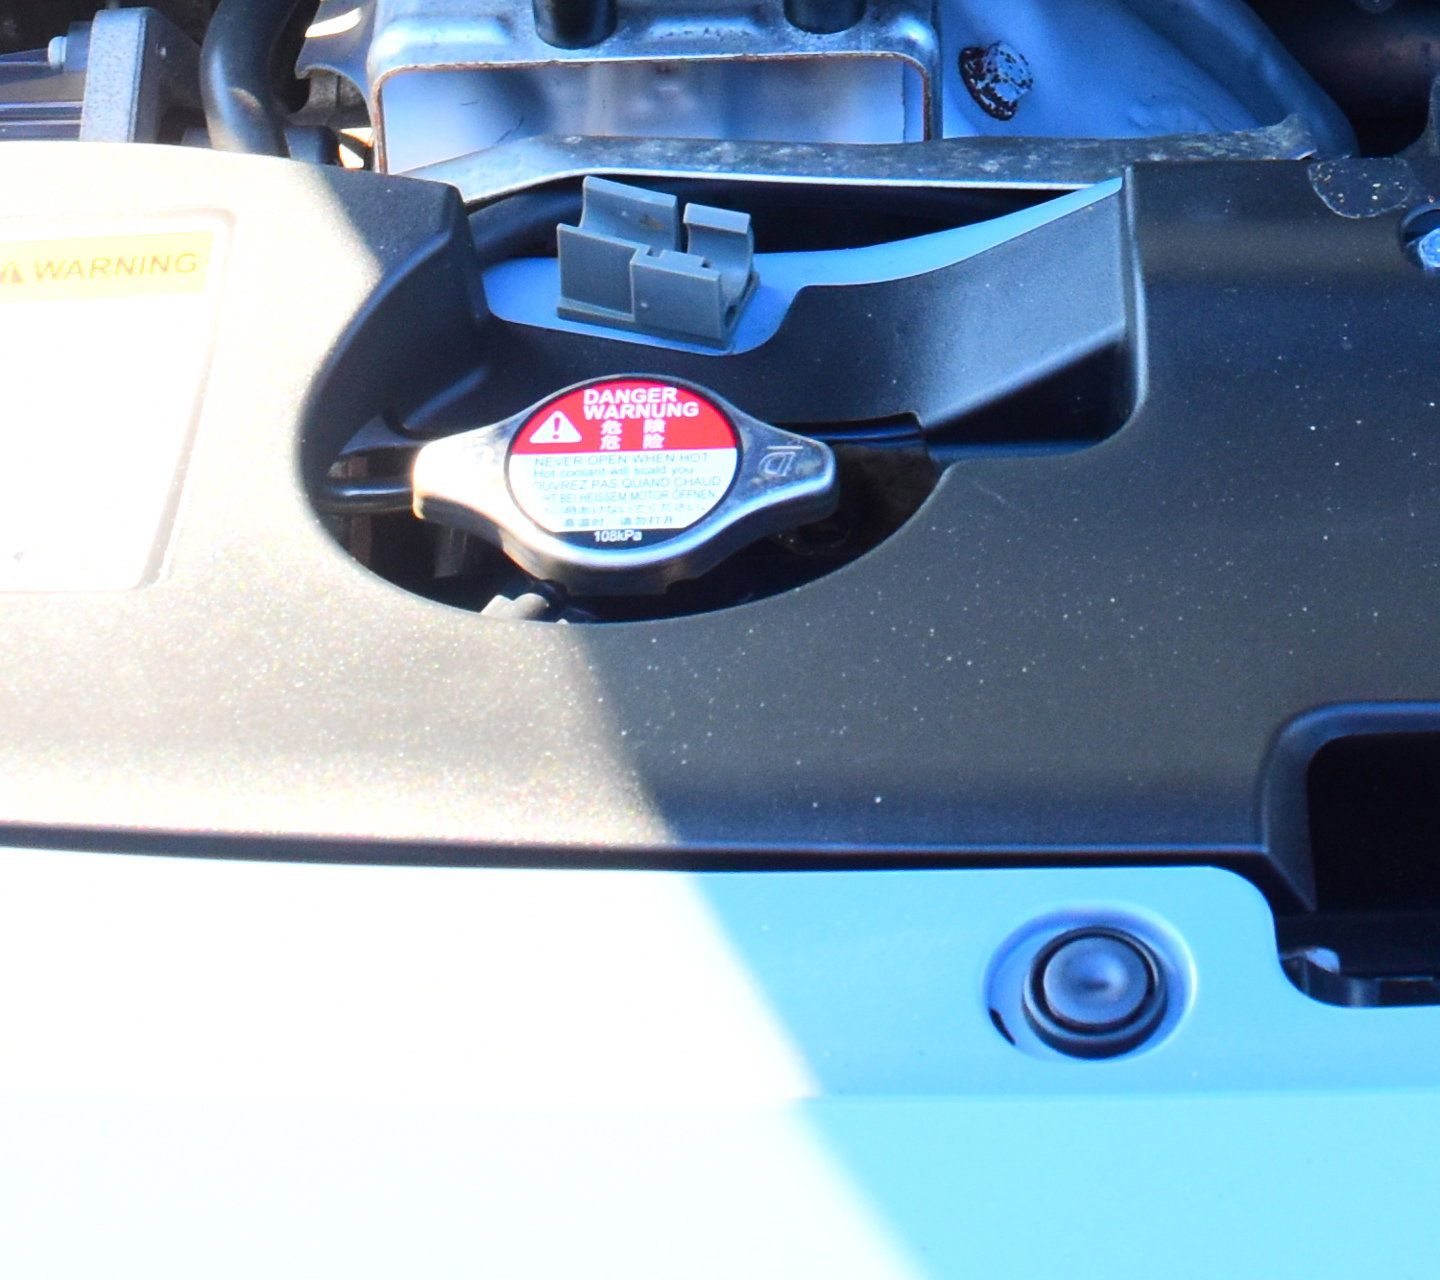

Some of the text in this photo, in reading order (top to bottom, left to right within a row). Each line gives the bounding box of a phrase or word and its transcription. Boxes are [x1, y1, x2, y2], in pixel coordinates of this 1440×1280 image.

[34, 251, 199, 281] WARNING
[583, 387, 678, 405] DANGER
[583, 401, 699, 420] WARNUNG
[535, 451, 708, 468] NEVER OPEN WHEN HOT
[534, 468, 556, 479] Hot
[560, 466, 606, 477] coolant
[610, 465, 630, 476] will
[633, 464, 668, 475] scald
[591, 477, 619, 489] PAS
[622, 476, 670, 489] QUAND
[674, 474, 721, 486] CHAUD
[560, 492, 577, 503] BEI
[579, 490, 627, 502] HEISSEM
[630, 489, 669, 500] MOTOR
[594, 530, 642, 543] 108kPa
